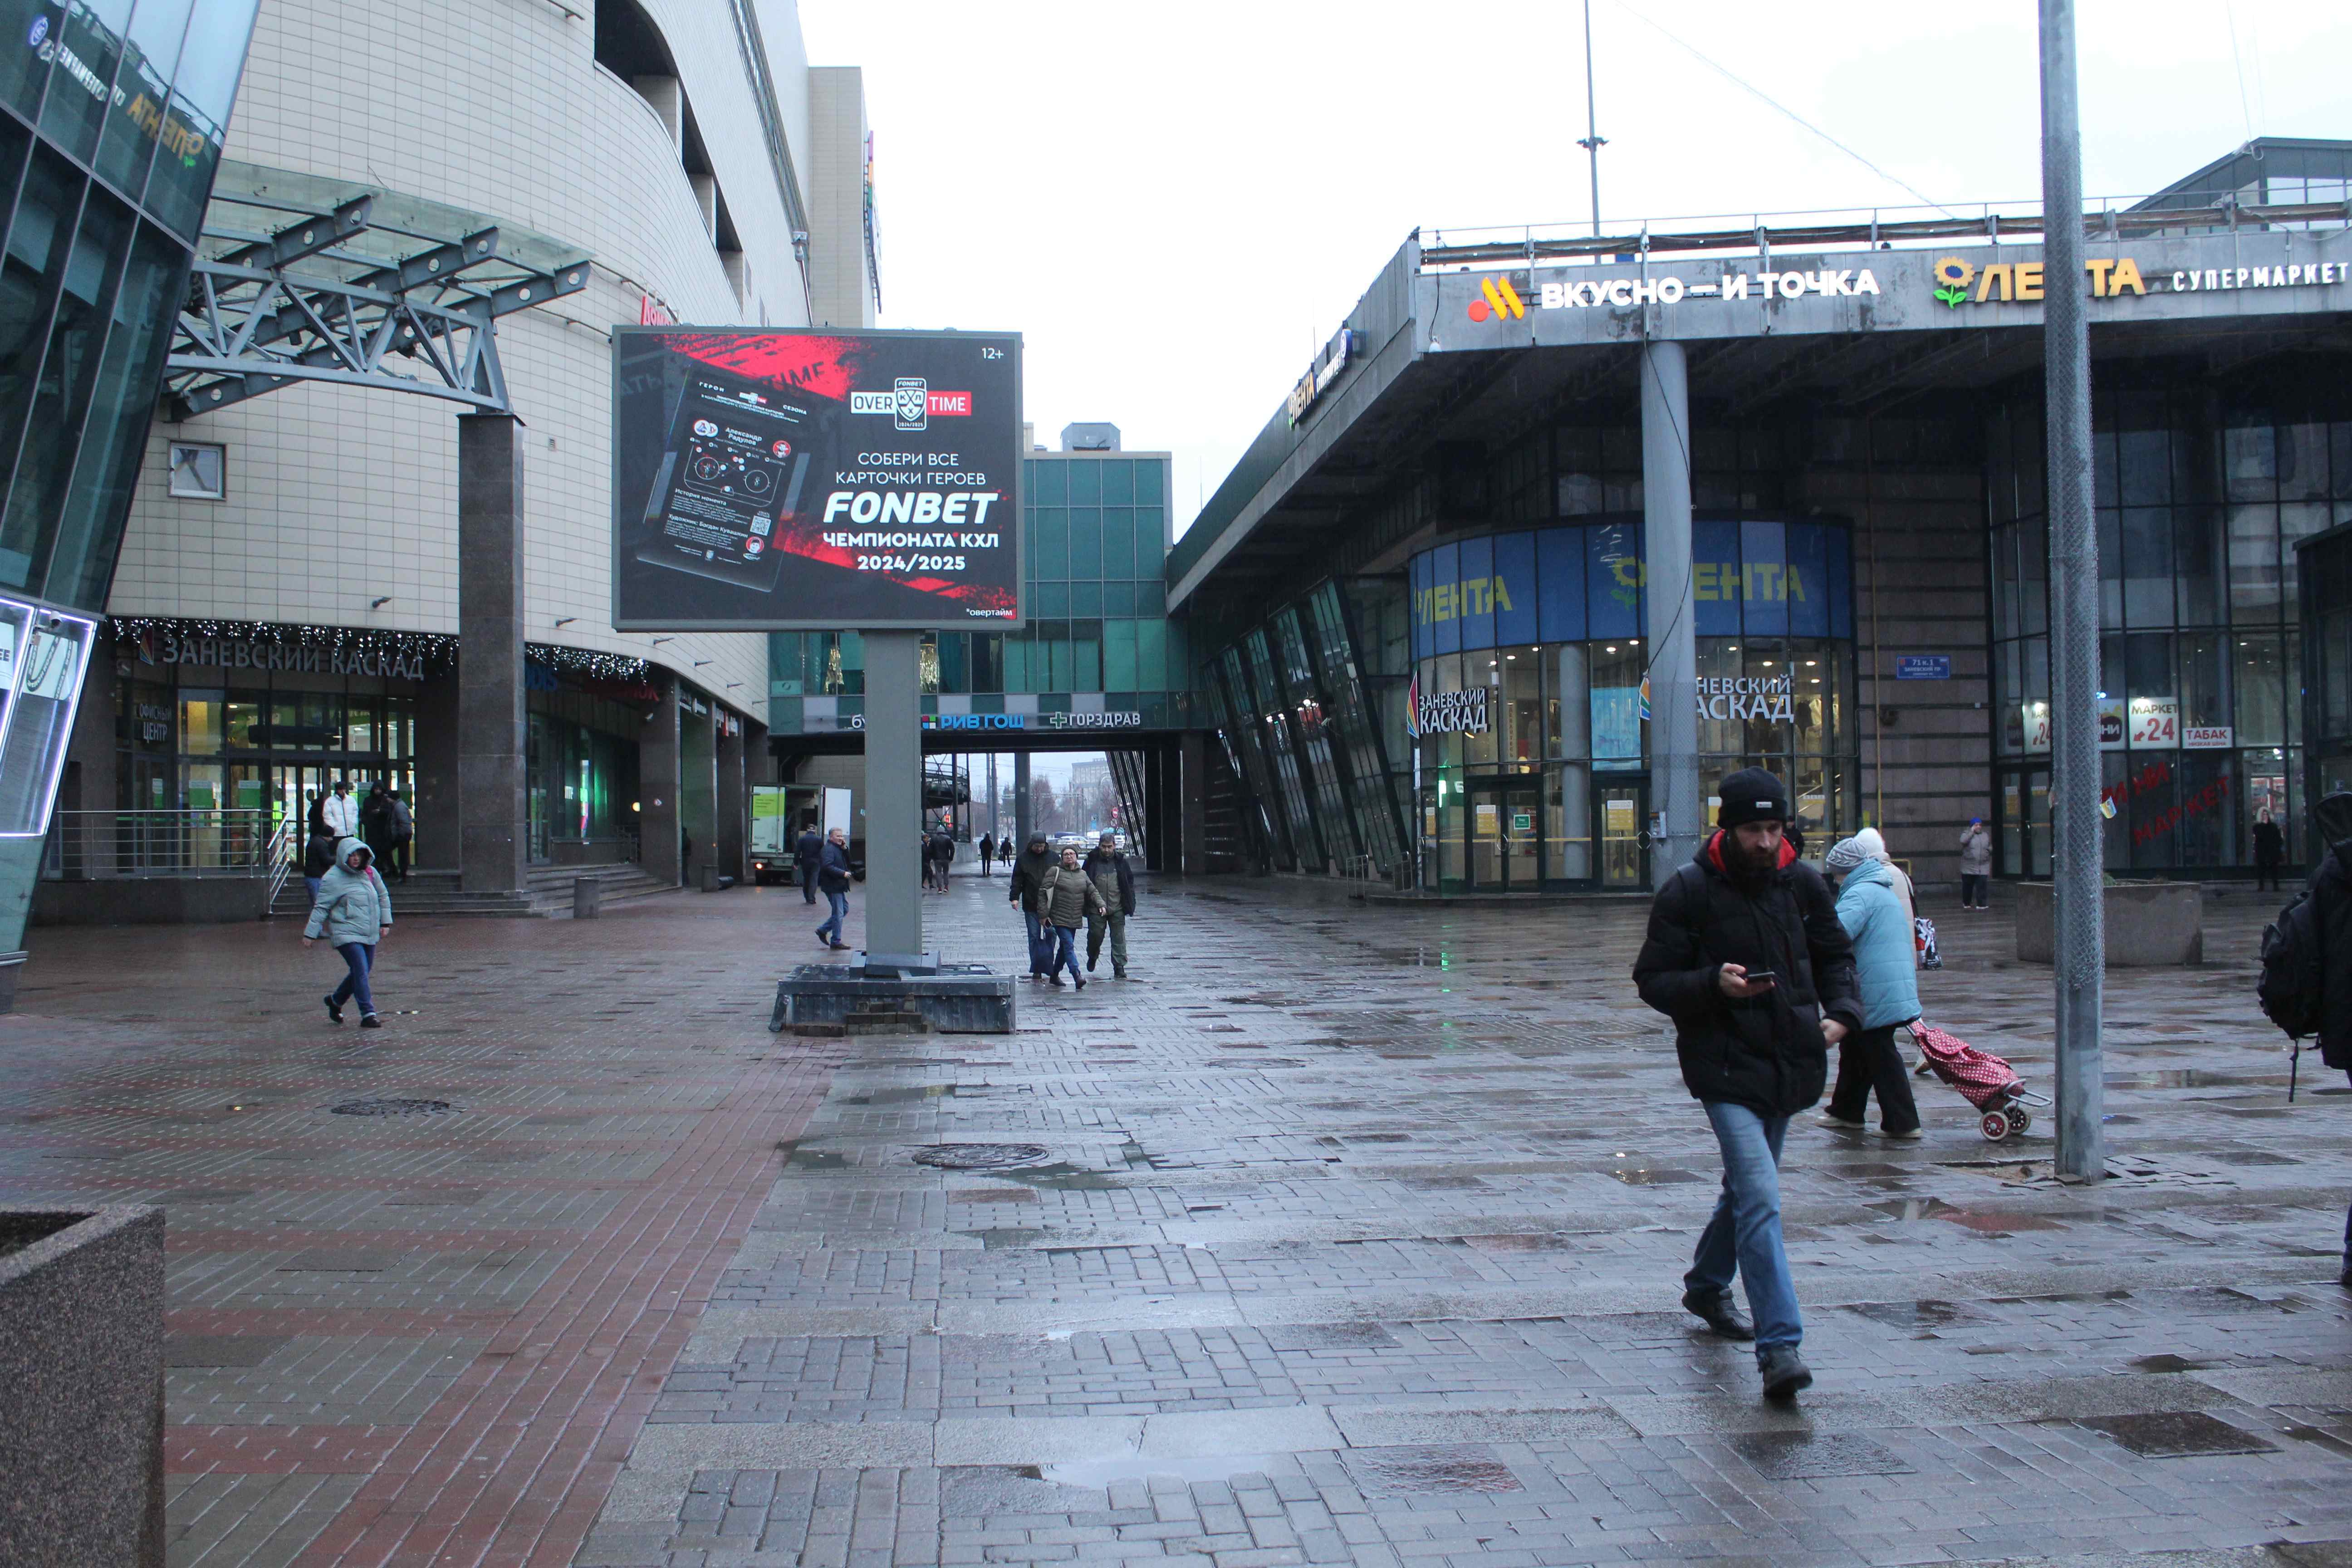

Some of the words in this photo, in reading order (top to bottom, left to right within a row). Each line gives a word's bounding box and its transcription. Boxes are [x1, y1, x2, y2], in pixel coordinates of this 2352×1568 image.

[1975, 258, 2146, 302] ЛЕТА
[2172, 262, 2349, 291] СУПЕРМАРКЕТ
[1541, 277, 1684, 309] ВКУСНО
[1723, 274, 1747, 301] И
[1757, 269, 1880, 299] ТОЧКА
[982, 348, 1004, 359] 12+
[783, 404, 807, 415] СЕЗОНА
[854, 396, 893, 410] OVER
[929, 396, 966, 412] TIME
[725, 427, 762, 442] Александр
[728, 433, 756, 446] Радулов
[858, 453, 922, 466] СОБЕРИ
[928, 454, 959, 466] ВСЕ
[836, 471, 921, 485] КАРТОЧКИ
[927, 472, 986, 485] ГЕРОЕВ
[675, 488, 700, 500] История
[823, 491, 999, 524] FONBET
[699, 520, 719, 532] Богдан
[823, 533, 956, 547] ЧЕМПИОНАТА
[961, 533, 999, 548] КХЛ
[858, 554, 966, 572] 2024/2025
[1693, 563, 1806, 602] ЕНТА
[1423, 576, 1513, 625] ЛЕНТА
[162, 637, 318, 672] ЗАНЕВСКИЙ
[330, 652, 424, 680] КАСКАД
[1696, 674, 1791, 694] НЕВСКИЙ
[1419, 687, 1485, 711] ЗАНЕВСКИЙ
[139, 703, 172, 722] ОФИСНЫЙ
[1696, 694, 1794, 723] АСКАД
[2132, 704, 2177, 715] МАРКЕТ
[941, 715, 980, 729] РИВ
[984, 715, 1024, 728] ГОШ
[1068, 713, 1141, 727] ГОРЗДРАВ
[1420, 705, 1487, 734] КАСКАД
[142, 721, 168, 744] ЦЕНТР
[2147, 718, 2175, 741] 24
[2186, 730, 2227, 740] ТАБАК
